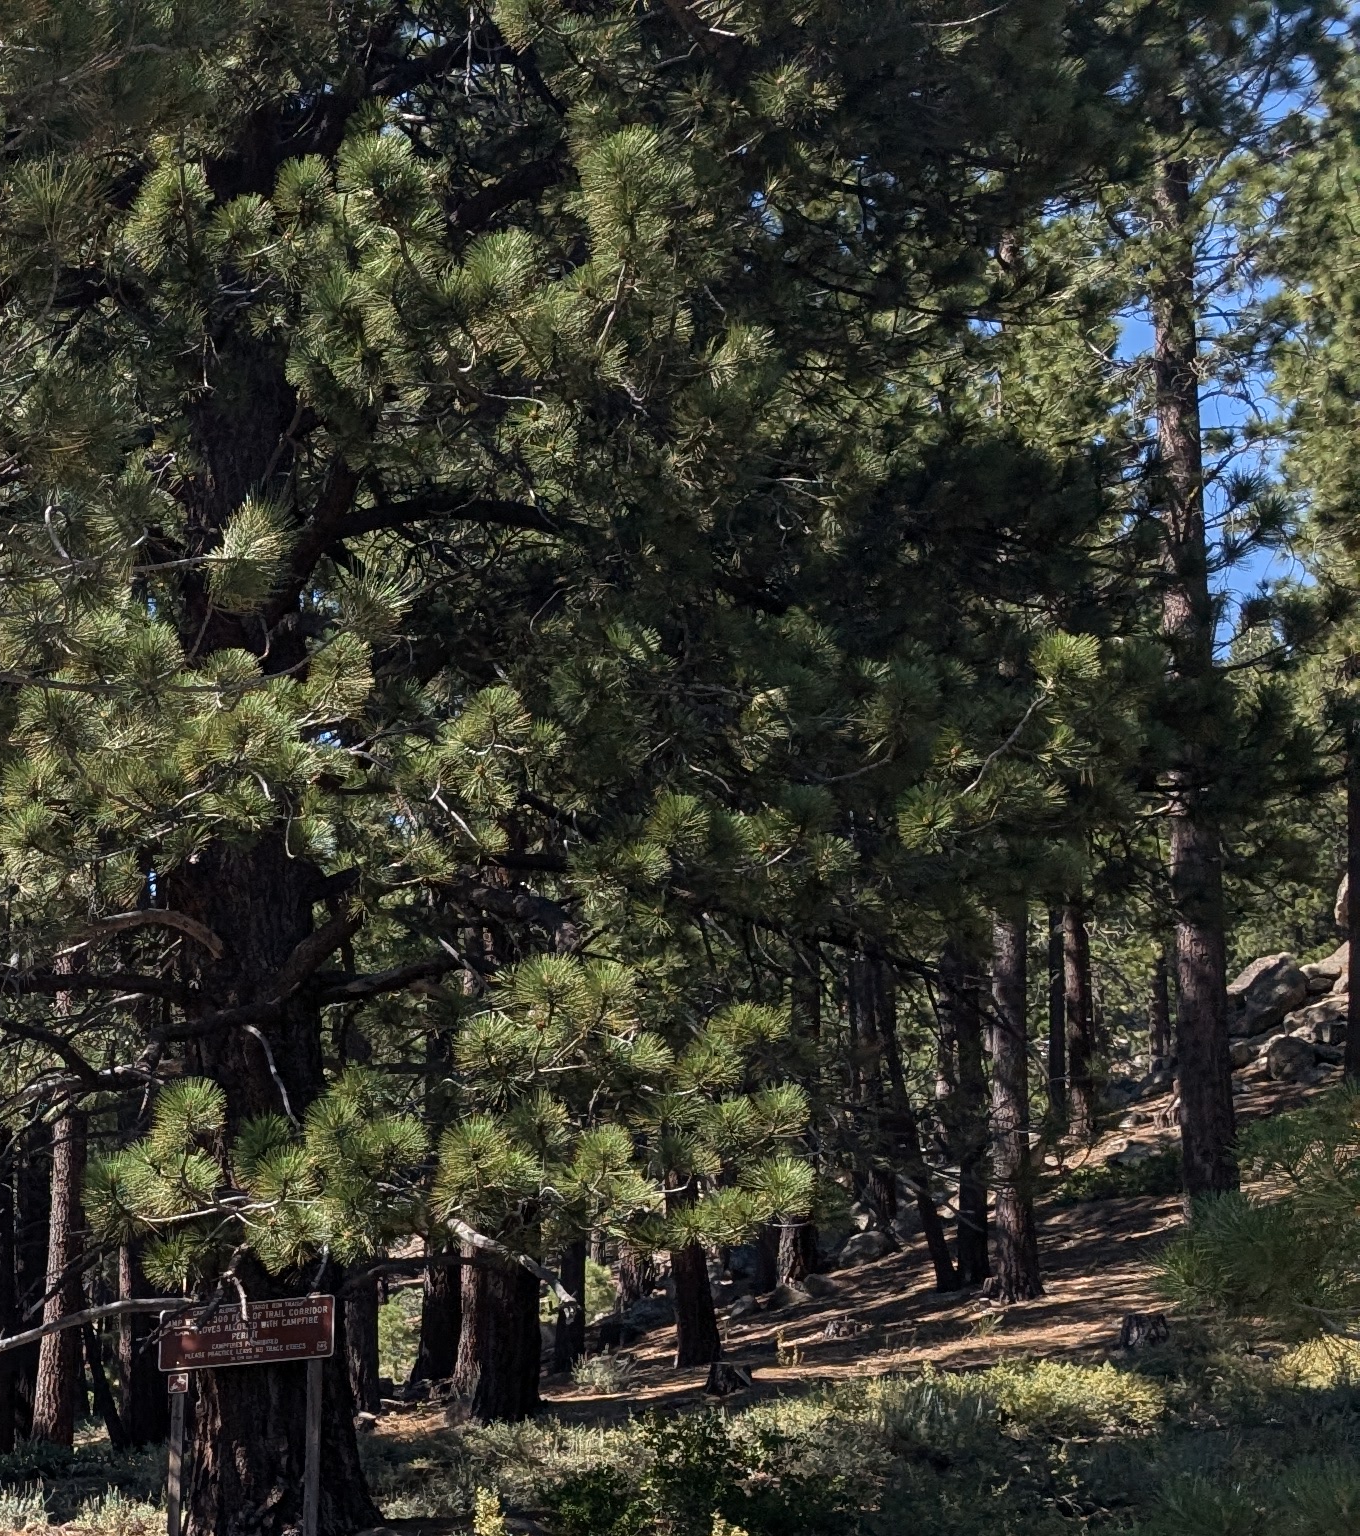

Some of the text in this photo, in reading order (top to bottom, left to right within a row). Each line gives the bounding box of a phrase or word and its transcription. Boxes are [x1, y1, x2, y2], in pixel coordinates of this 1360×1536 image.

[253, 1312, 262, 1320] OF
[265, 1310, 286, 1319] TRAIL
[289, 1306, 328, 1317] CORRIDOR
[261, 1320, 279, 1329] WITH
[282, 1315, 319, 1327] CAMPFIRE
